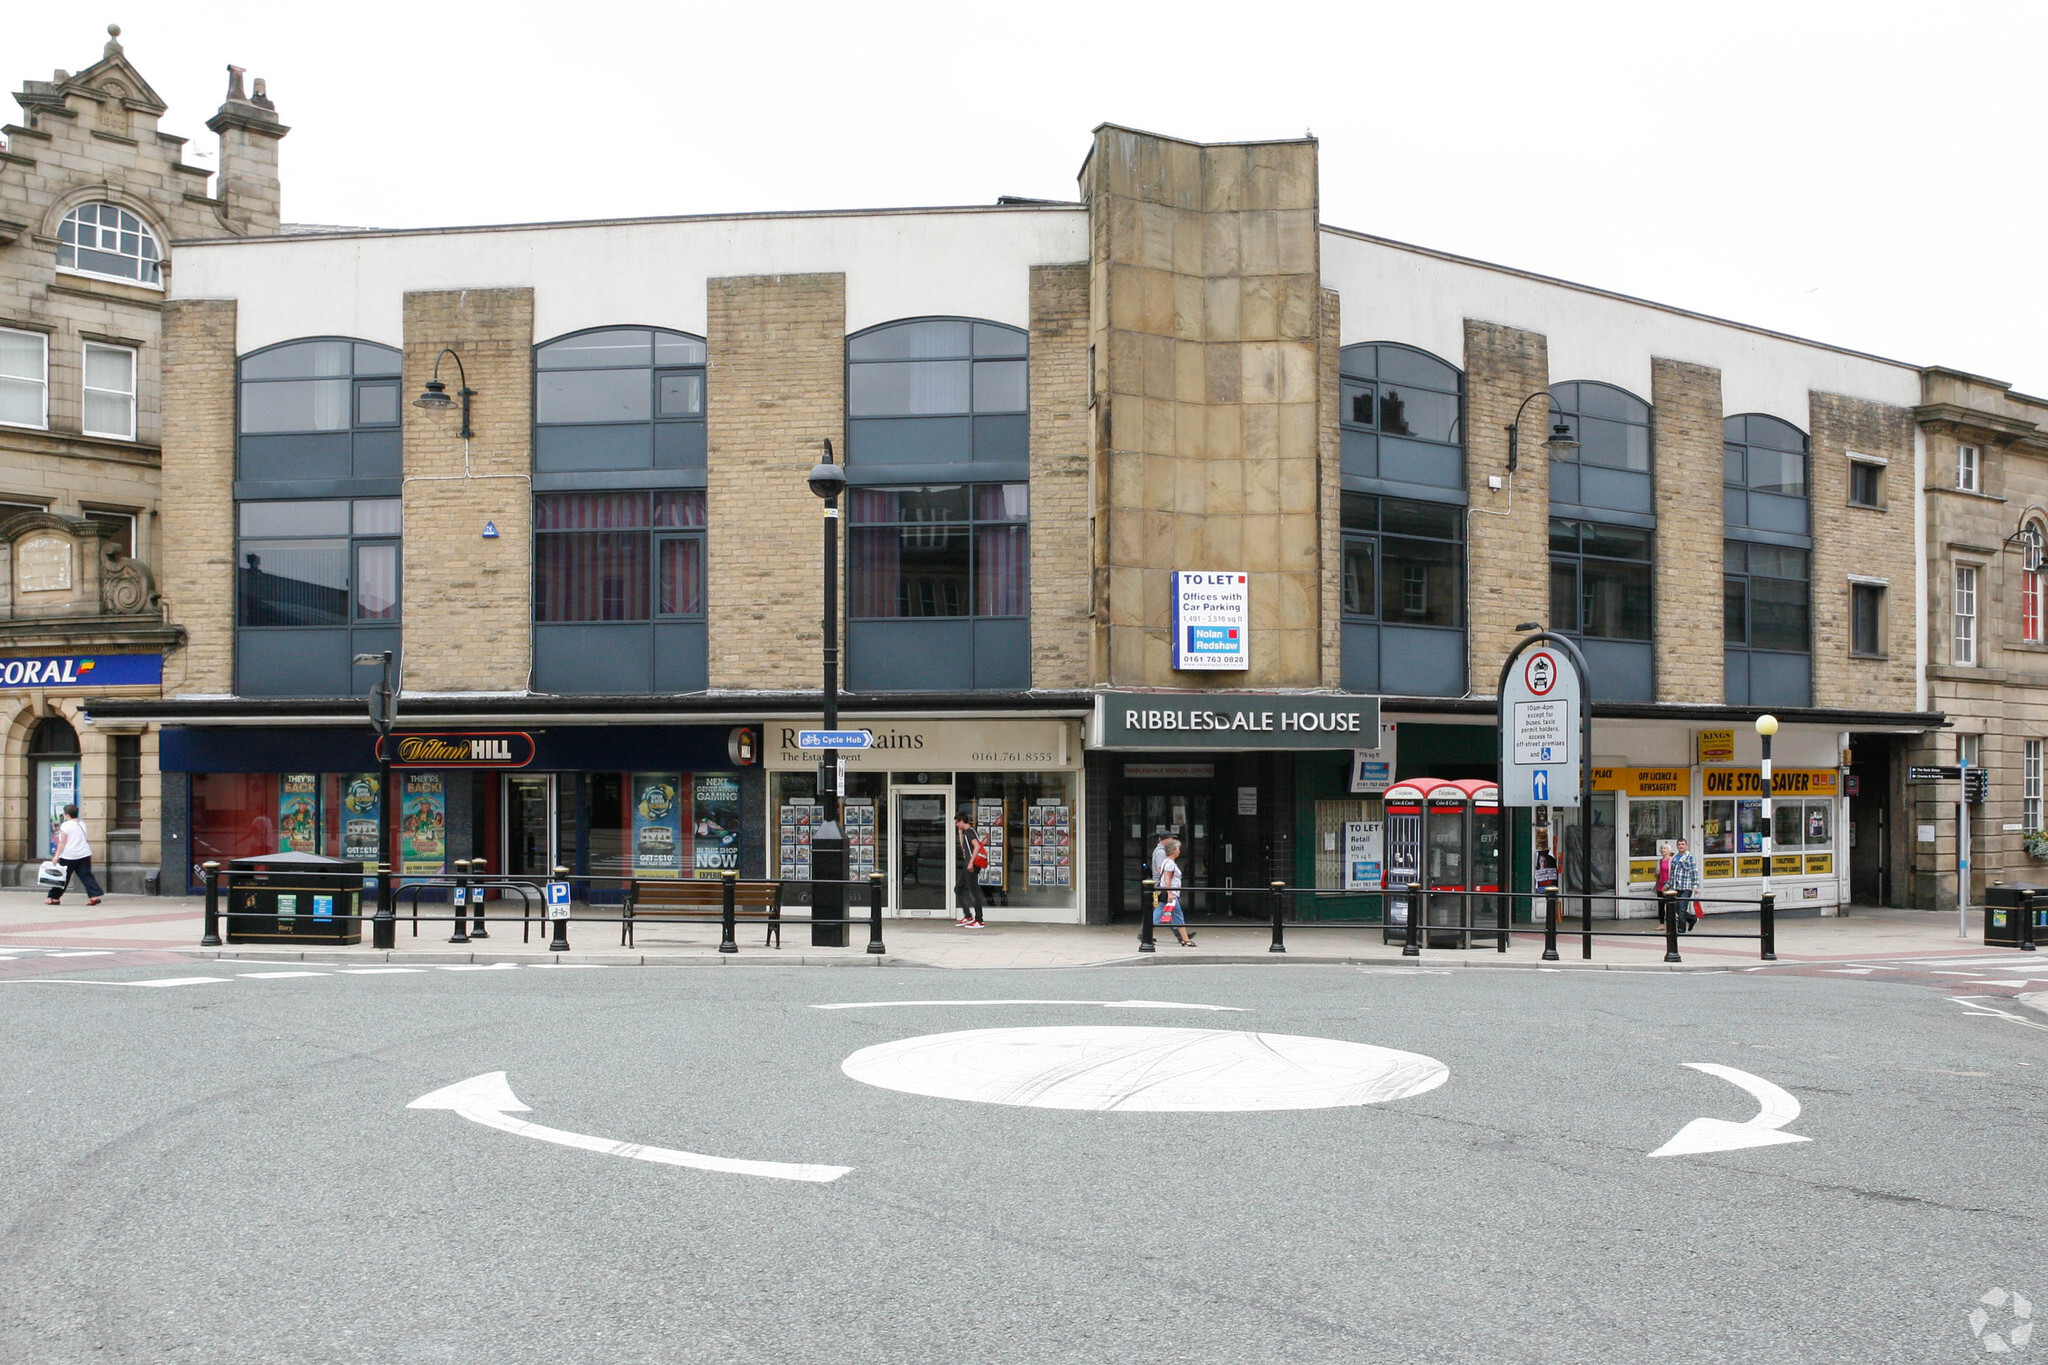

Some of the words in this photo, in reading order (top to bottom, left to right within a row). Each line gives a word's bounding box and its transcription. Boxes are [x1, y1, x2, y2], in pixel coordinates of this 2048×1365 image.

[1184, 575, 1202, 584] TO
[1208, 575, 1233, 584] LET
[1183, 592, 1217, 600] Offices
[1183, 603, 1200, 611] Car
[1203, 603, 1240, 612] Parking
[1196, 629, 1223, 638] Nolan
[1196, 641, 1237, 650] Redshaw
[1126, 711, 1273, 731] RIBBLESDALE
[1282, 712, 1360, 732] HOUSE
[823, 736, 844, 744] Cycle
[399, 737, 471, 762] William
[471, 740, 511, 759] HILL
[781, 752, 799, 761] The
[802, 752, 825, 761] Esta
[972, 752, 1052, 761] 0161.761.8555
[1595, 770, 1612, 778] PLACE
[1639, 772, 1649, 780] OFF
[1650, 772, 1672, 780] LICENCE
[1673, 772, 1677, 780] &
[706, 778, 728, 786] NEXT
[1708, 773, 1733, 791] ONE
[1772, 774, 1810, 791] SAVER
[408, 782, 442, 792] BACK!
[1640, 783, 1677, 791] NEWSAGENTS
[697, 792, 737, 801] GAMING
[1350, 824, 1361, 832] TO
[1437, 834, 1448, 842] BT
[1481, 834, 1493, 842] BT
[696, 854, 738, 868] NOW
[456, 889, 463, 898] P
[552, 885, 566, 903] P
